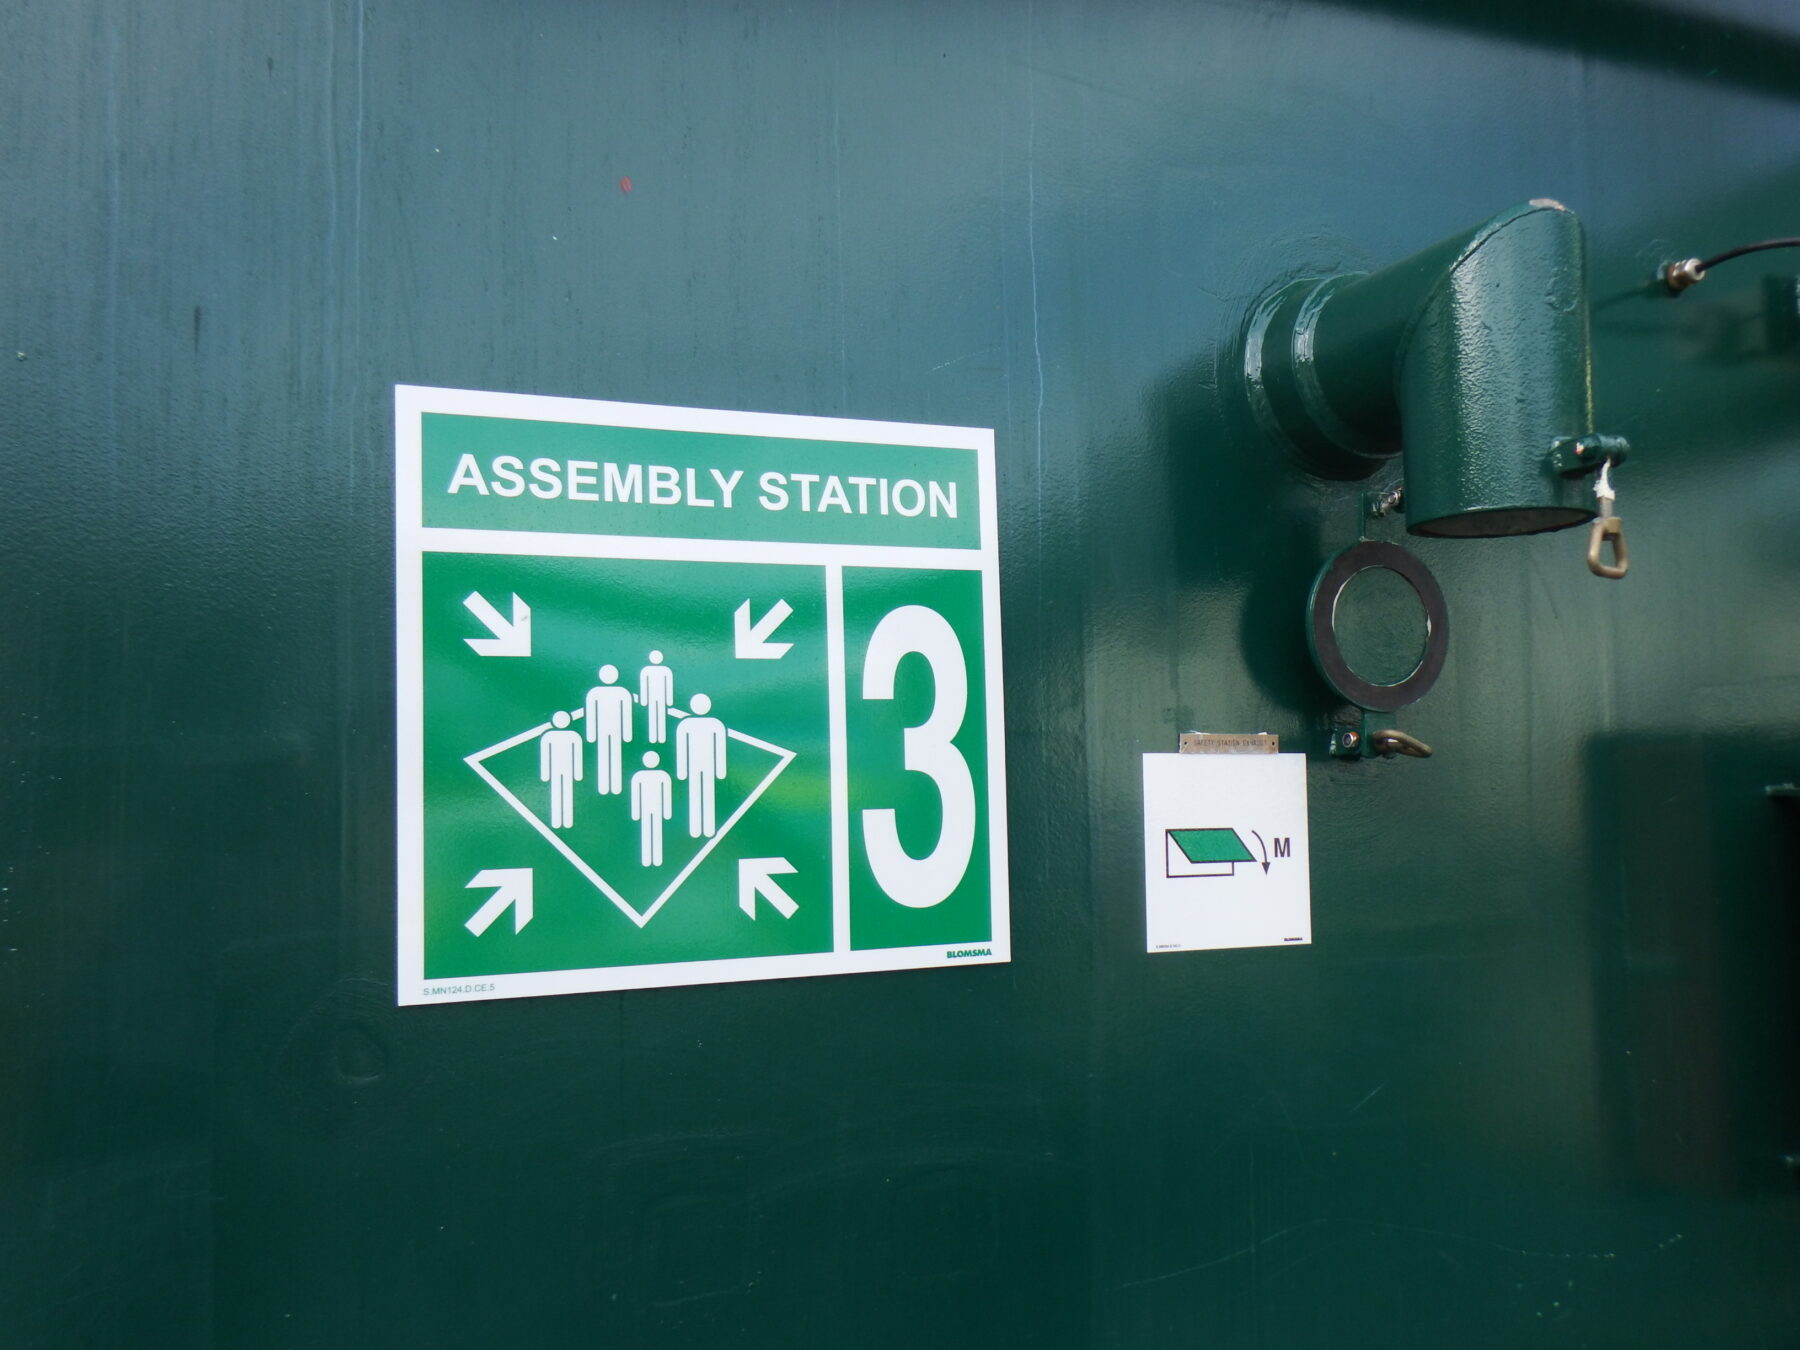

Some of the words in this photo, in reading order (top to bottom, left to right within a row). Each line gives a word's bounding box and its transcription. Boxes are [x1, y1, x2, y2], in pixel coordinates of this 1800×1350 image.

[448, 453, 744, 508] ASSEMBLY
[758, 471, 958, 518] STATION
[862, 604, 976, 909] 3
[1274, 837, 1291, 858] M
[946, 948, 992, 958] BLOMSMA
